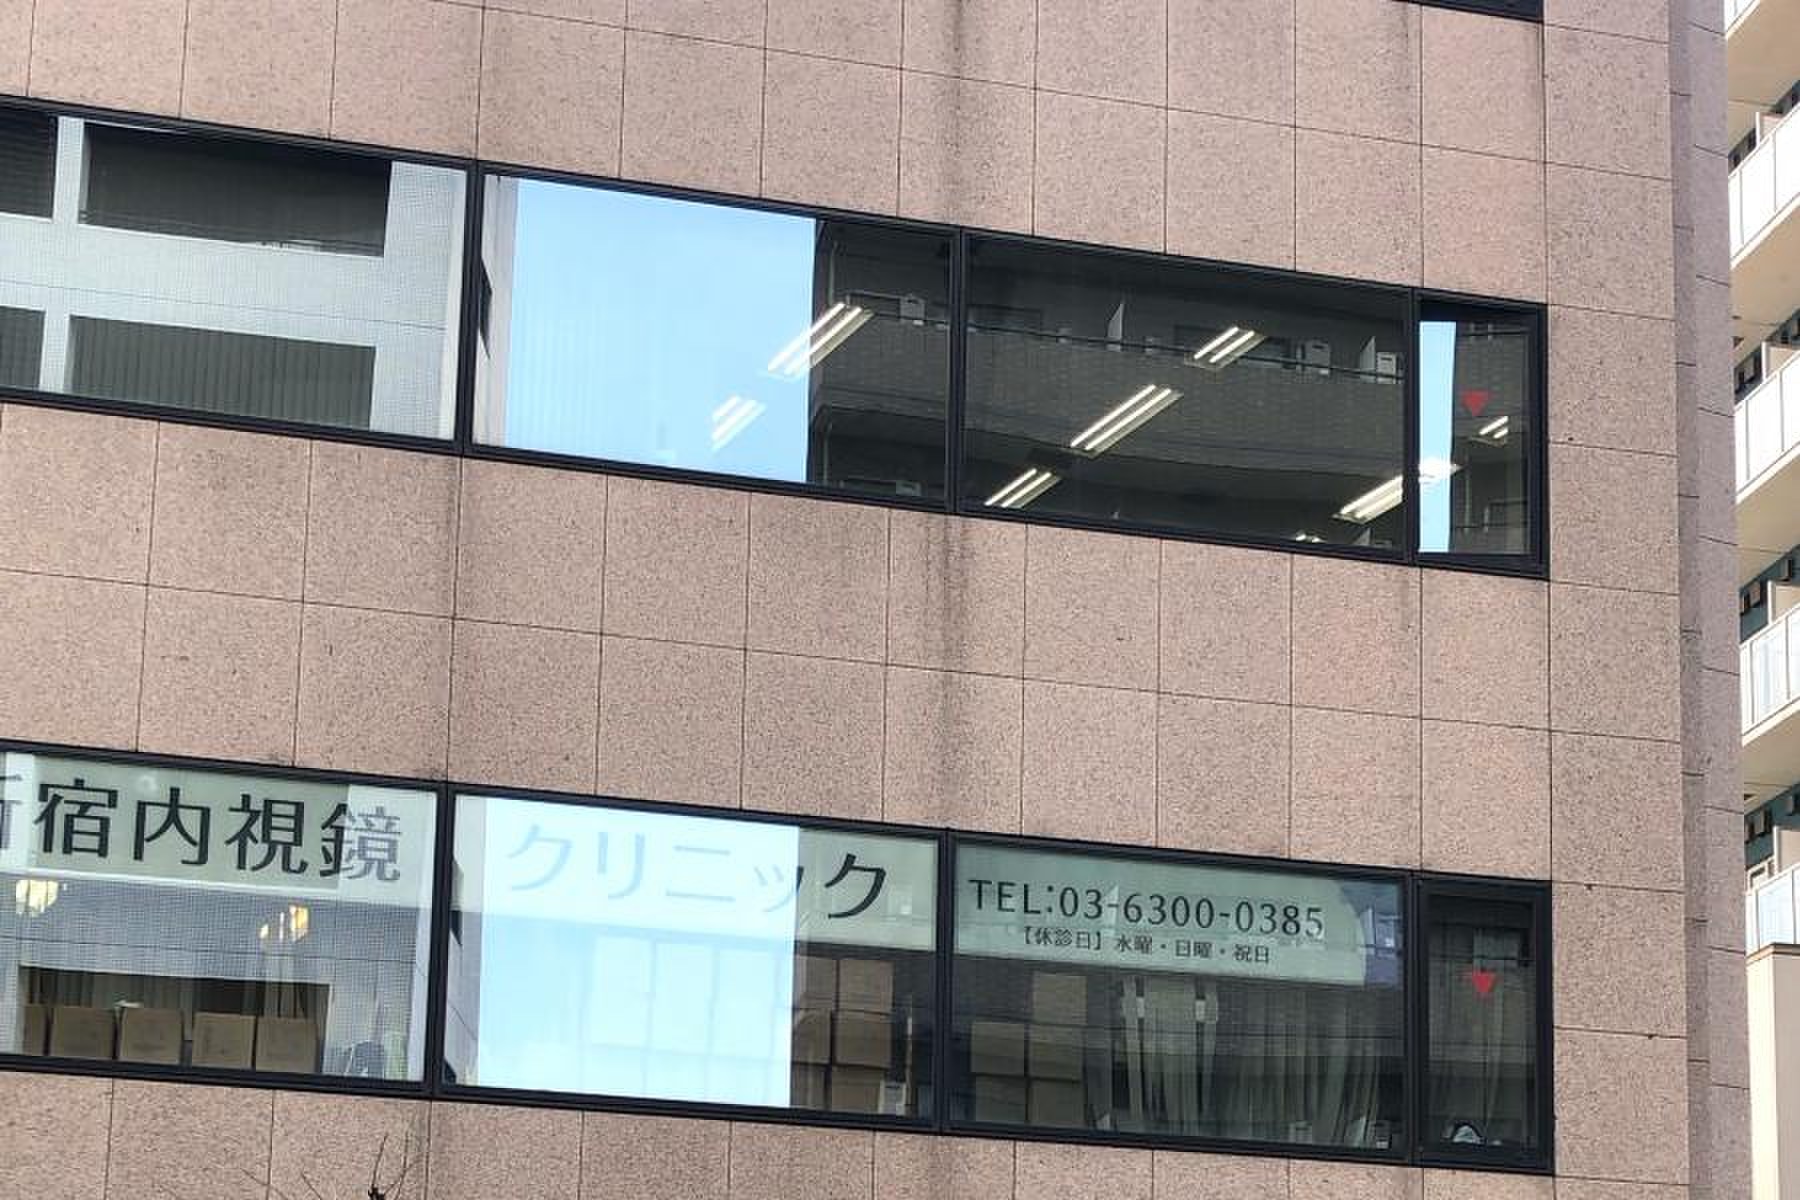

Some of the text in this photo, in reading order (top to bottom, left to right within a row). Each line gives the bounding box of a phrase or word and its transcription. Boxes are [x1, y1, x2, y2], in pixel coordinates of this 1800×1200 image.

[507, 823, 887, 919] クリニック
